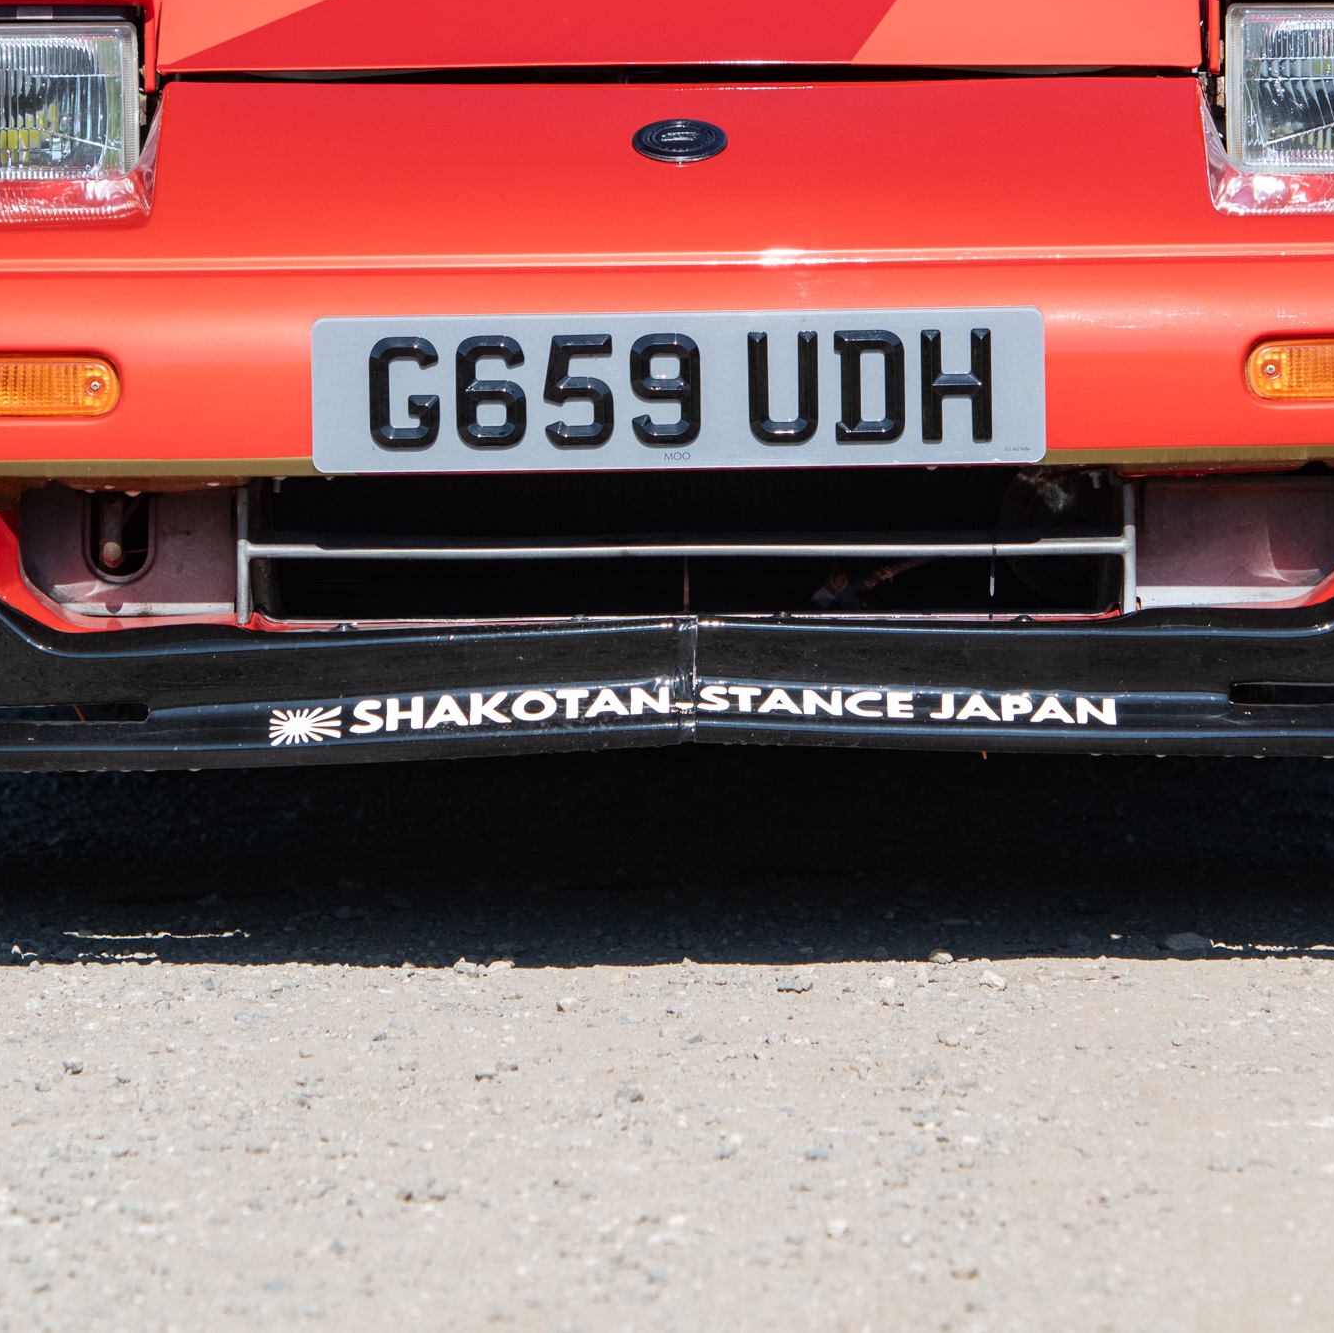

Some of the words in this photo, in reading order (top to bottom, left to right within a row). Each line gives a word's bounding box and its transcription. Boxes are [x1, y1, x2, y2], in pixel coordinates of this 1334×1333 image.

[368, 332, 701, 449] G659
[746, 328, 993, 444] UDH
[664, 451, 691, 461] MOO
[349, 687, 671, 734] SHAKOTAN
[695, 685, 915, 719] STANCE
[929, 693, 1118, 726] JAPAN
